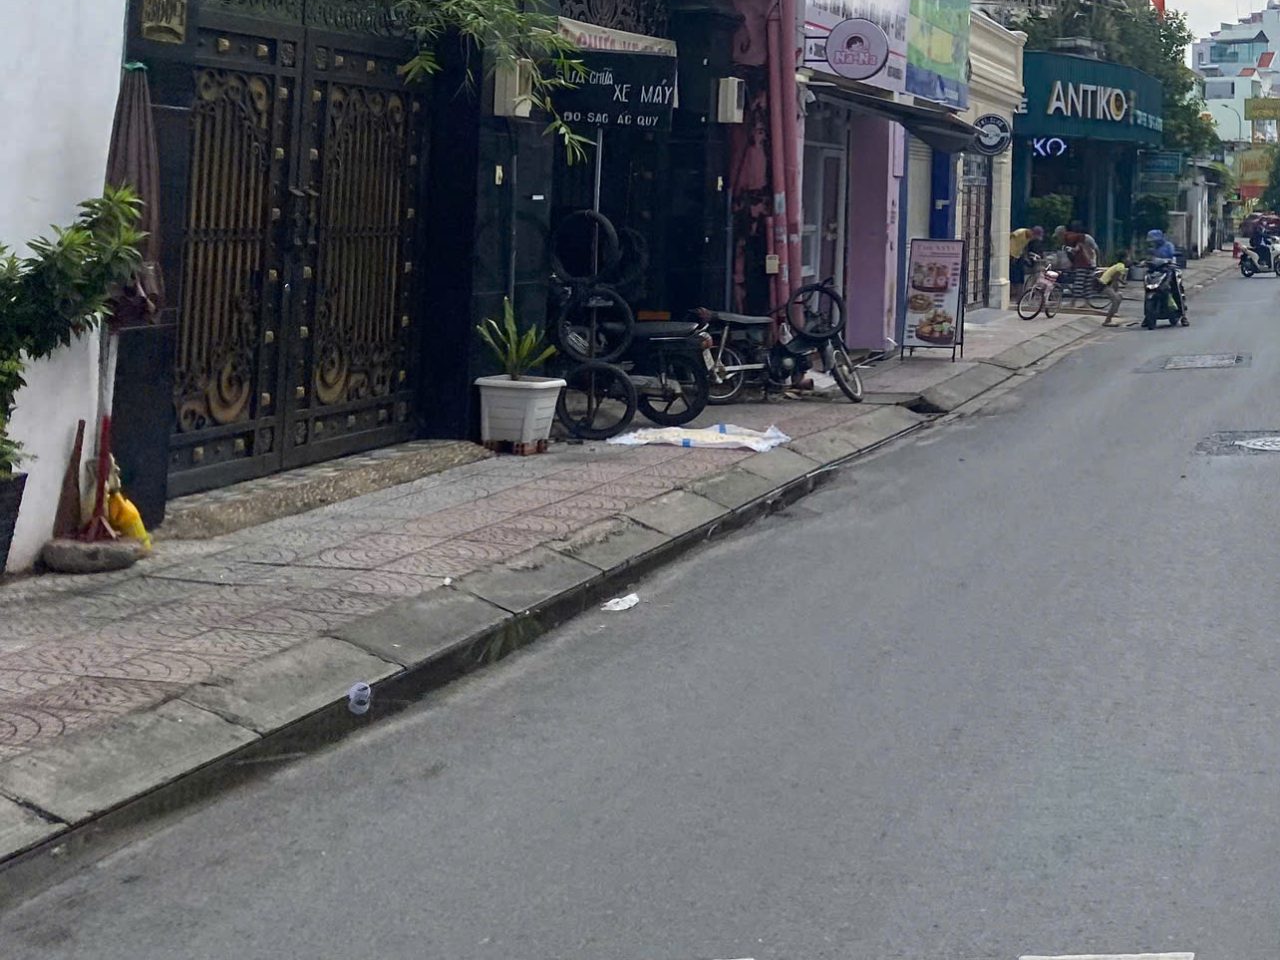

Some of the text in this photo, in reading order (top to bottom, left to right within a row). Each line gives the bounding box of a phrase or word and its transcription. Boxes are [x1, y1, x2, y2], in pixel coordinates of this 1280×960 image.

[613, 78, 673, 105] XE MÁY
[1047, 80, 1128, 121] ANTIKO
[637, 115, 659, 126] QUY
